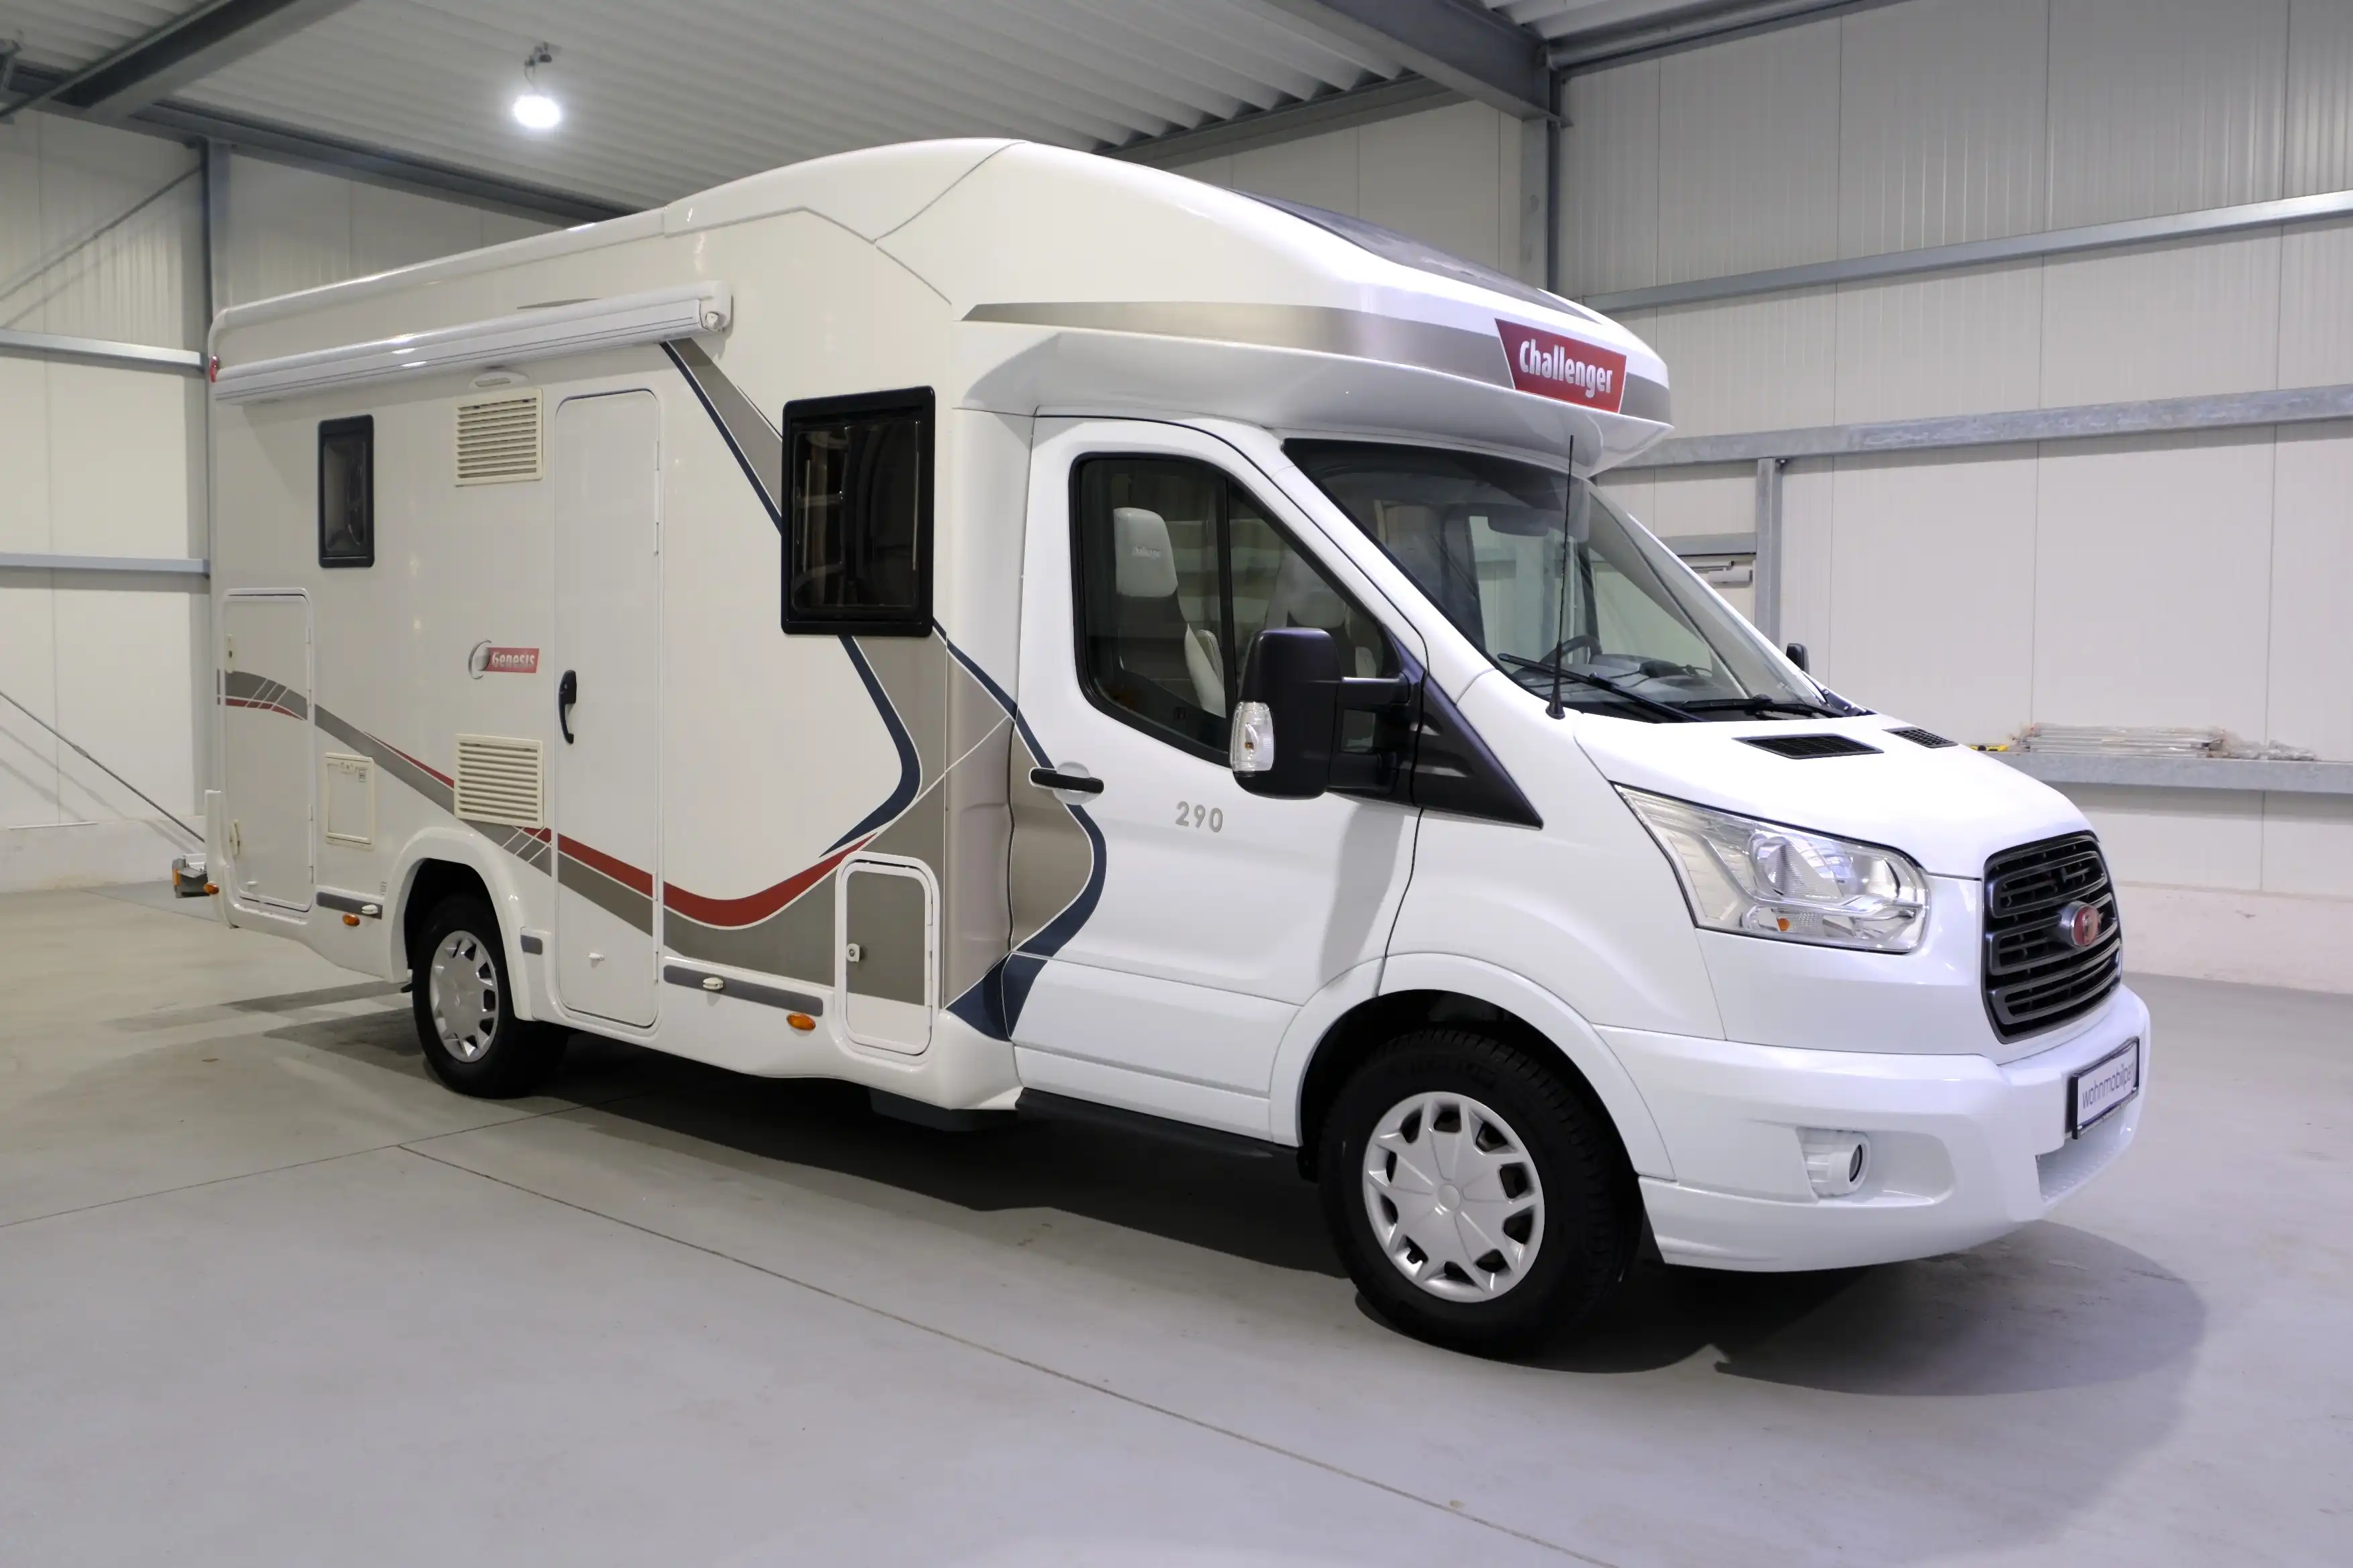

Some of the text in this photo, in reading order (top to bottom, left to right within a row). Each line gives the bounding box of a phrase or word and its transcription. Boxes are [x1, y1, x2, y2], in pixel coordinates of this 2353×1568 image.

[1519, 339, 1612, 398] Challenger
[492, 651, 535, 668] Genesis
[1175, 801, 1223, 832] 290
